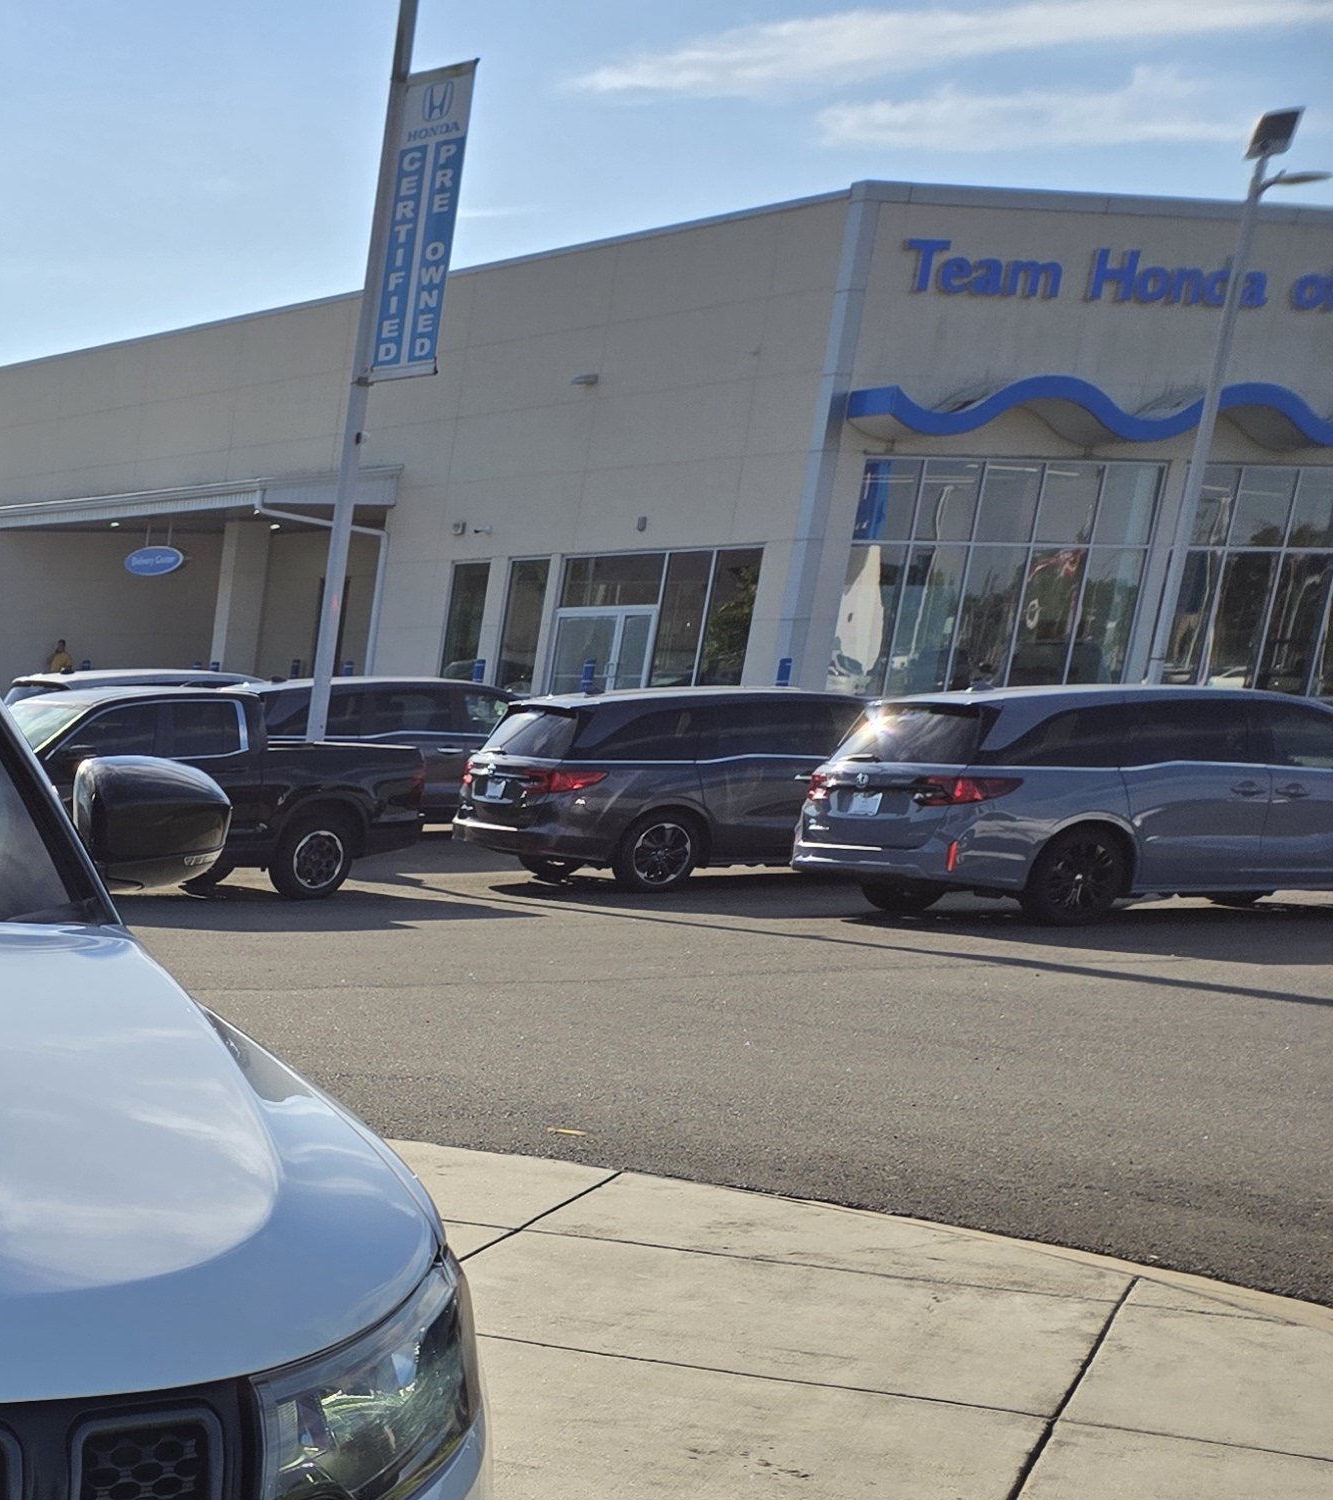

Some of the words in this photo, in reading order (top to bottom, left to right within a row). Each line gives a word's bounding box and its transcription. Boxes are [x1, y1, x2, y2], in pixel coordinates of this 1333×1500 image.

[406, 120, 461, 143] HONDA
[433, 144, 457, 215] PRE
[377, 150, 422, 362] CERTIFIED
[904, 238, 1062, 299] Team
[413, 241, 446, 358] OWNED
